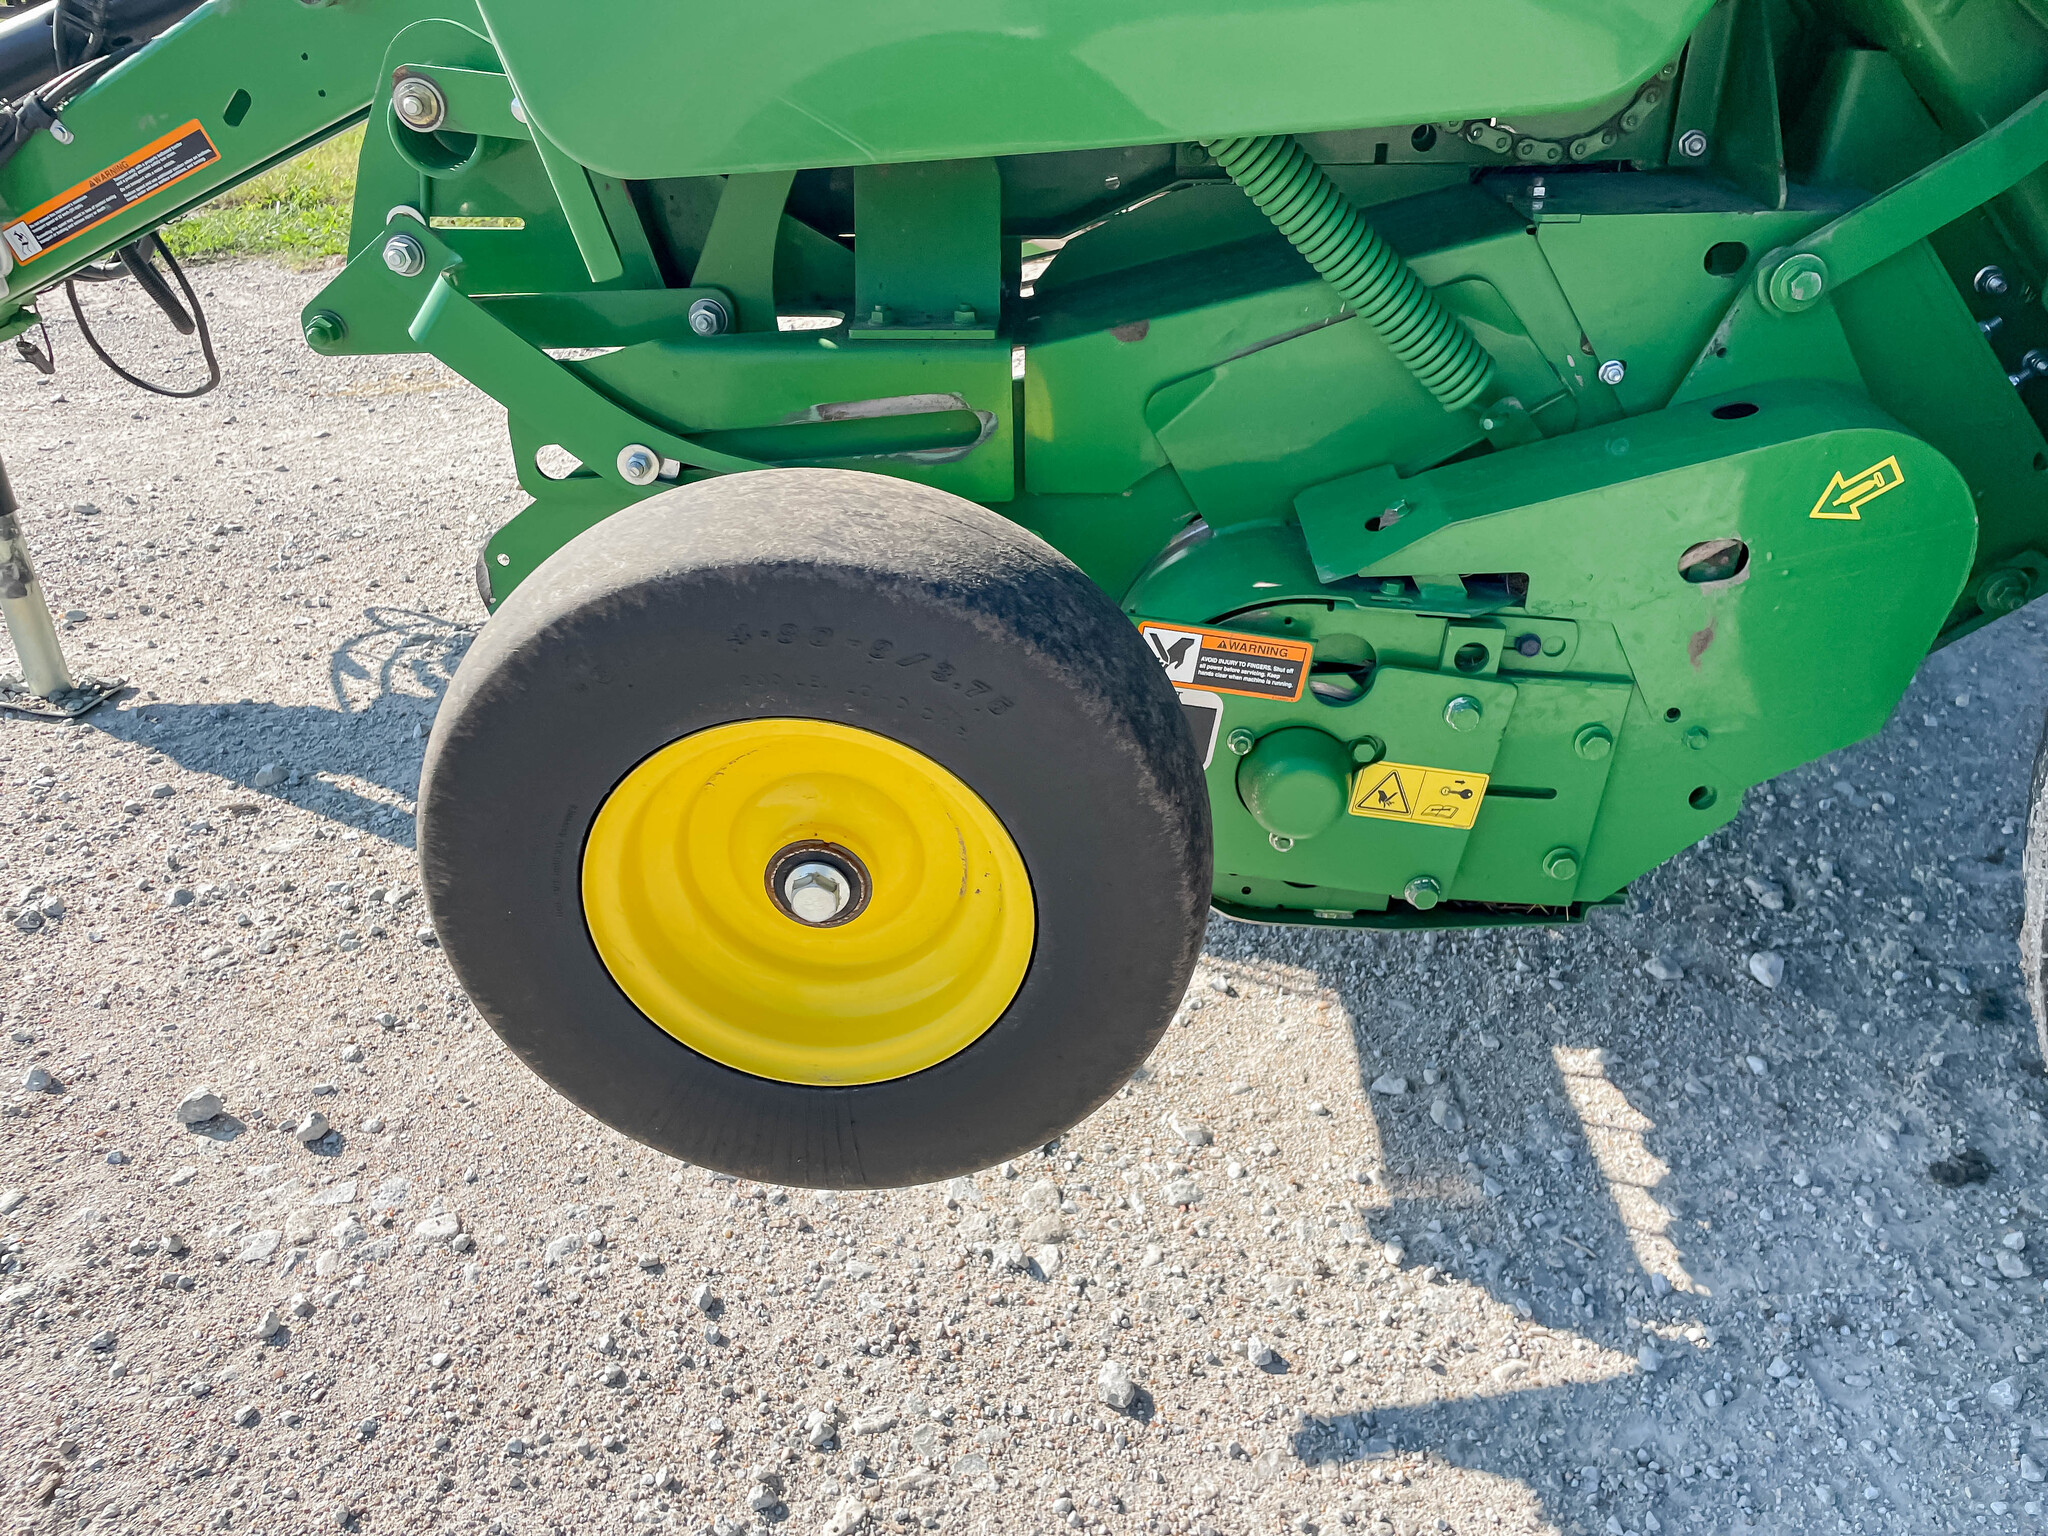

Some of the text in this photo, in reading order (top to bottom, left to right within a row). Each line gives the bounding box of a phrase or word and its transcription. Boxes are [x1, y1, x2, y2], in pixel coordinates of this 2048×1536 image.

[93, 161, 129, 184] WARNING
[1229, 641, 1288, 657] WARNING
[1218, 658, 1238, 666] INJURY
[1246, 662, 1272, 671] FINGERS.
[1273, 665, 1286, 673] Shut
[1241, 669, 1266, 678] servicing.
[1267, 672, 1281, 680] Keep
[1243, 676, 1265, 684] machine
[1271, 680, 1293, 689] running.
